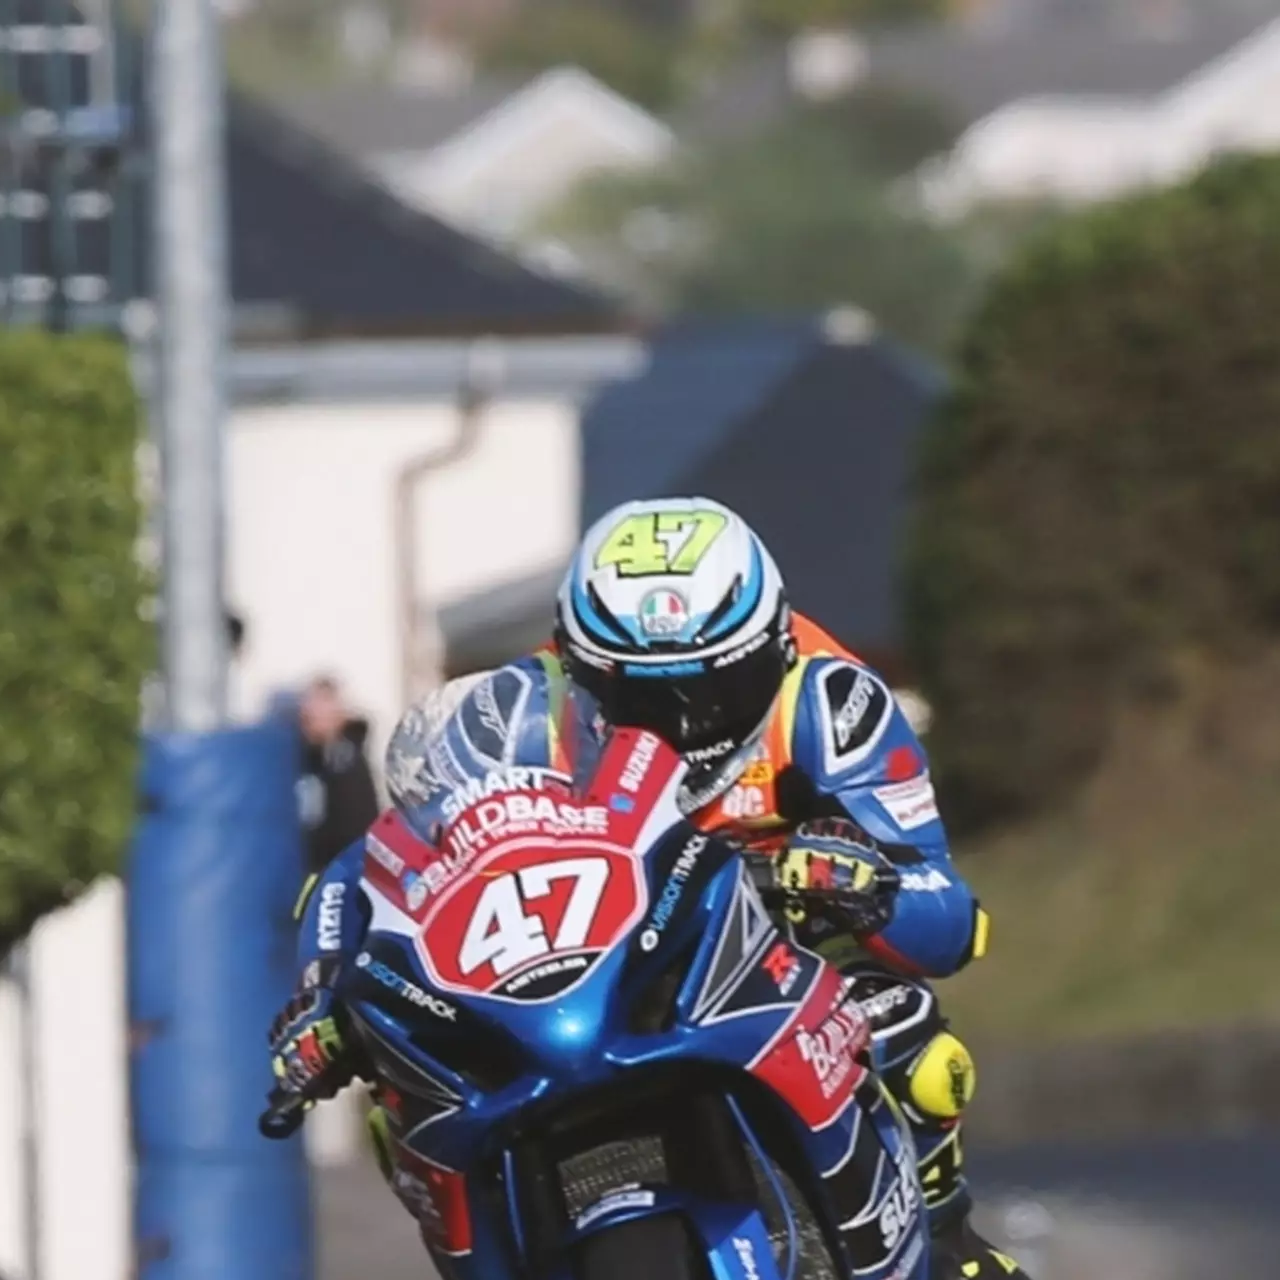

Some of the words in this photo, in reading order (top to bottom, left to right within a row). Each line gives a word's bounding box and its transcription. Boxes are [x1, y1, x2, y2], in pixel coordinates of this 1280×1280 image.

[593, 510, 729, 578] 47
[618, 730, 661, 792] SUZUKI
[440, 767, 546, 825] SMART
[422, 794, 608, 889] BUILDBASE
[458, 858, 610, 977] 47
